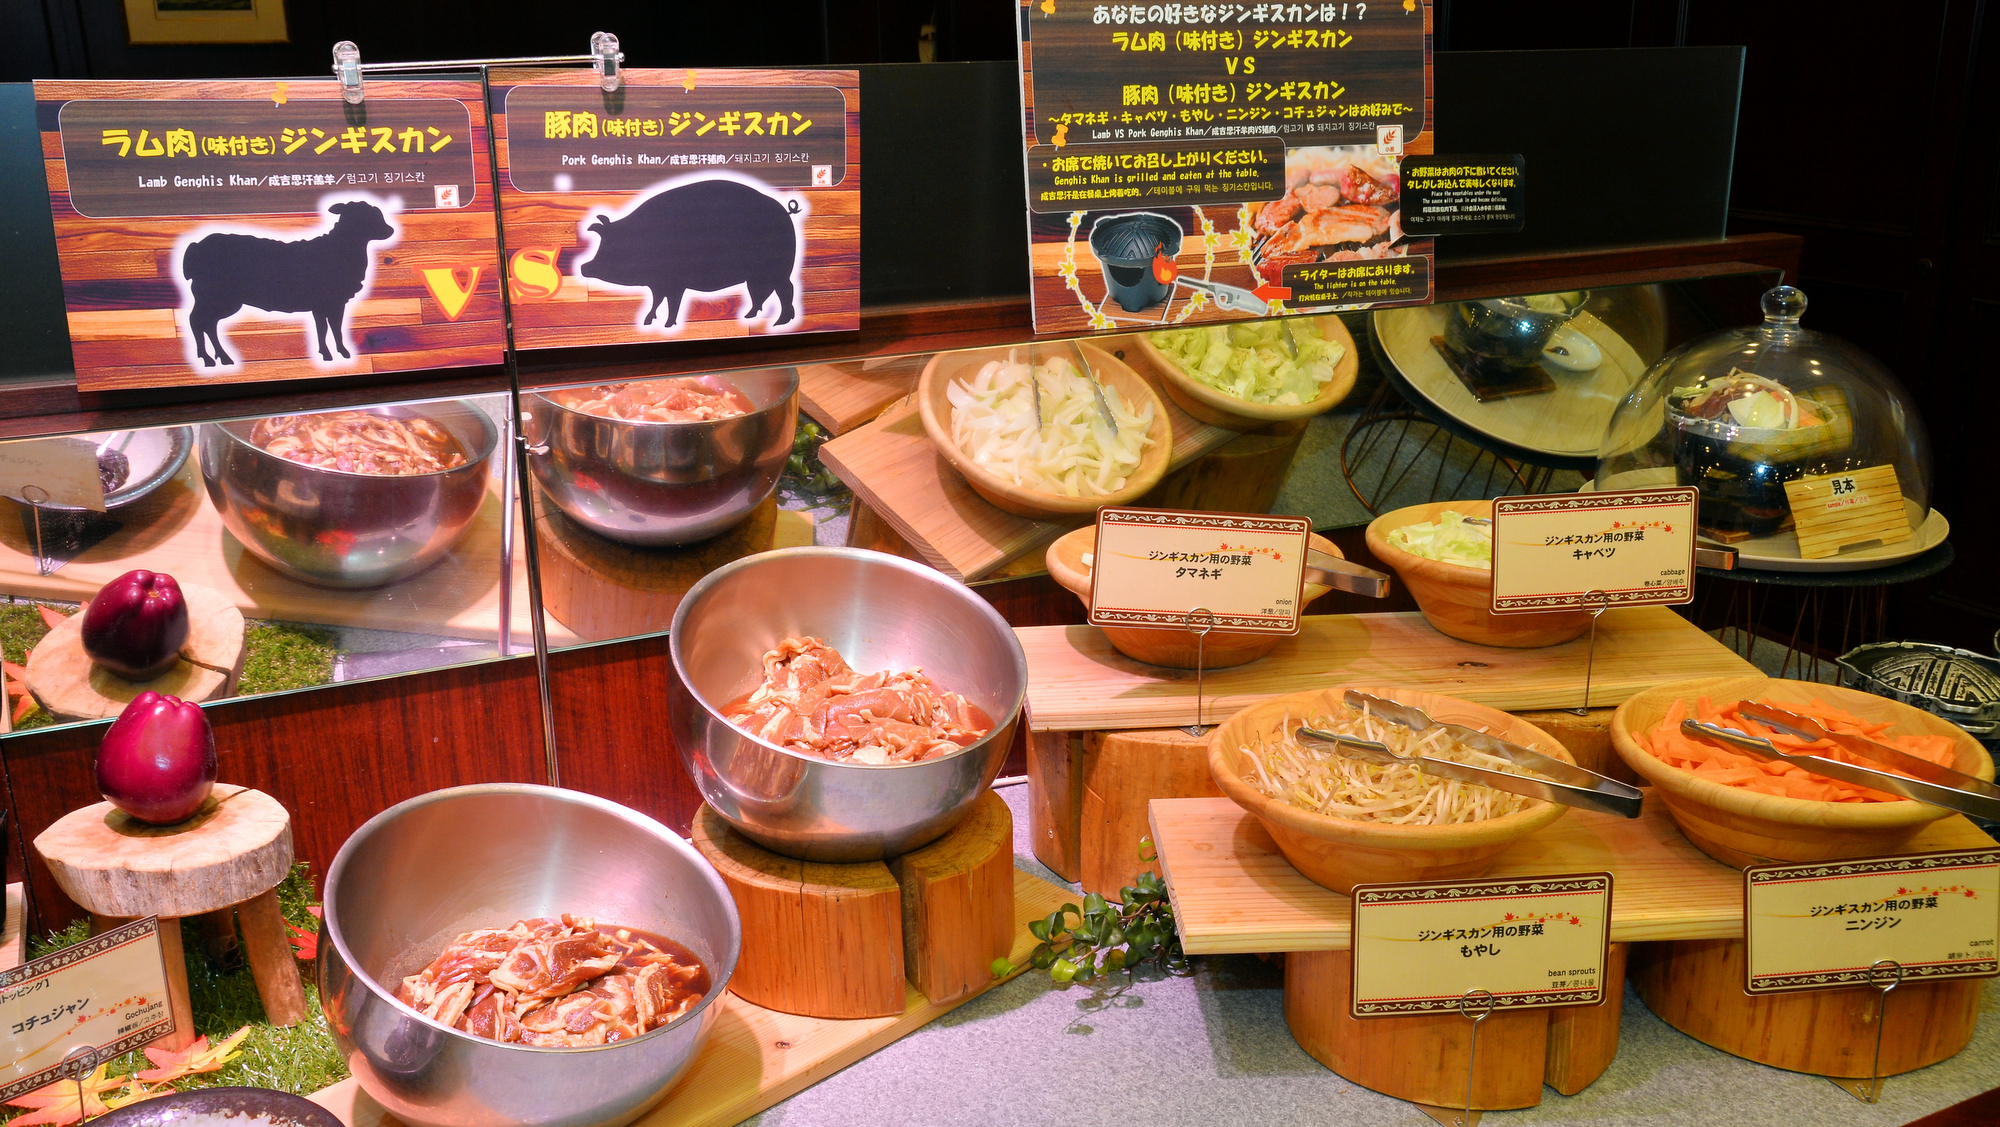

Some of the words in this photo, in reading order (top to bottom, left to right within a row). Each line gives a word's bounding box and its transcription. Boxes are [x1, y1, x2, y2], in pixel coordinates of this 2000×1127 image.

[1092, 2, 1367, 25] あなたの好きなジンギスカンは！？
[1111, 29, 1353, 52] ラム肉（味付き）ジンギスカン
[1225, 56, 1255, 75] VS
[1122, 81, 1346, 106] 豚肉（味付き）ジンギスカン
[544, 111, 813, 139] 豚肉(味付き)ジンギスカン
[1092, 129, 1111, 139] Lamb
[1114, 129, 1125, 138] VS
[1128, 128, 1147, 138] Pork
[1150, 127, 1182, 138] Genghis
[1307, 124, 1315, 132] VS
[101, 126, 453, 158] ラム肉(味付き)ジンギスカン
[562, 154, 586, 166] Pork
[591, 154, 633, 167] Genghis
[138, 175, 168, 188] Lamb
[173, 174, 224, 188] Genghis
[1054, 175, 1087, 186] Genghis
[1091, 174, 1110, 184] Khan
[1114, 173, 1123, 183] is
[1126, 172, 1159, 182] grilled
[1162, 171, 1176, 181] and
[1179, 170, 1202, 180] eaten
[1205, 169, 1215, 179] at
[1218, 169, 1232, 178] the
[1235, 168, 1260, 178] table.
[411, 263, 488, 322] V
[1314, 282, 1324, 290] The
[1831, 477, 1856, 495] 見本
[1544, 531, 1645, 546] ジンギスカン用の野菜
[1149, 550, 1252, 566] ジンギスカン用の野菜
[1572, 546, 1616, 560] キャベツ
[1176, 566, 1223, 580] タマネギ
[1810, 897, 1938, 918] ジンギスカン用の野菜
[1845, 915, 1901, 931] ニンジン
[1418, 923, 1545, 942] ジンギスカン用の野菜
[1460, 943, 1501, 958] もやし
[1548, 969, 1566, 977] bean
[1568, 967, 1596, 976] sprouts
[0, 978, 50, 1004] トッピング】
[12, 998, 90, 1035] コチュジャン
[125, 1000, 163, 1021] Gochujang
